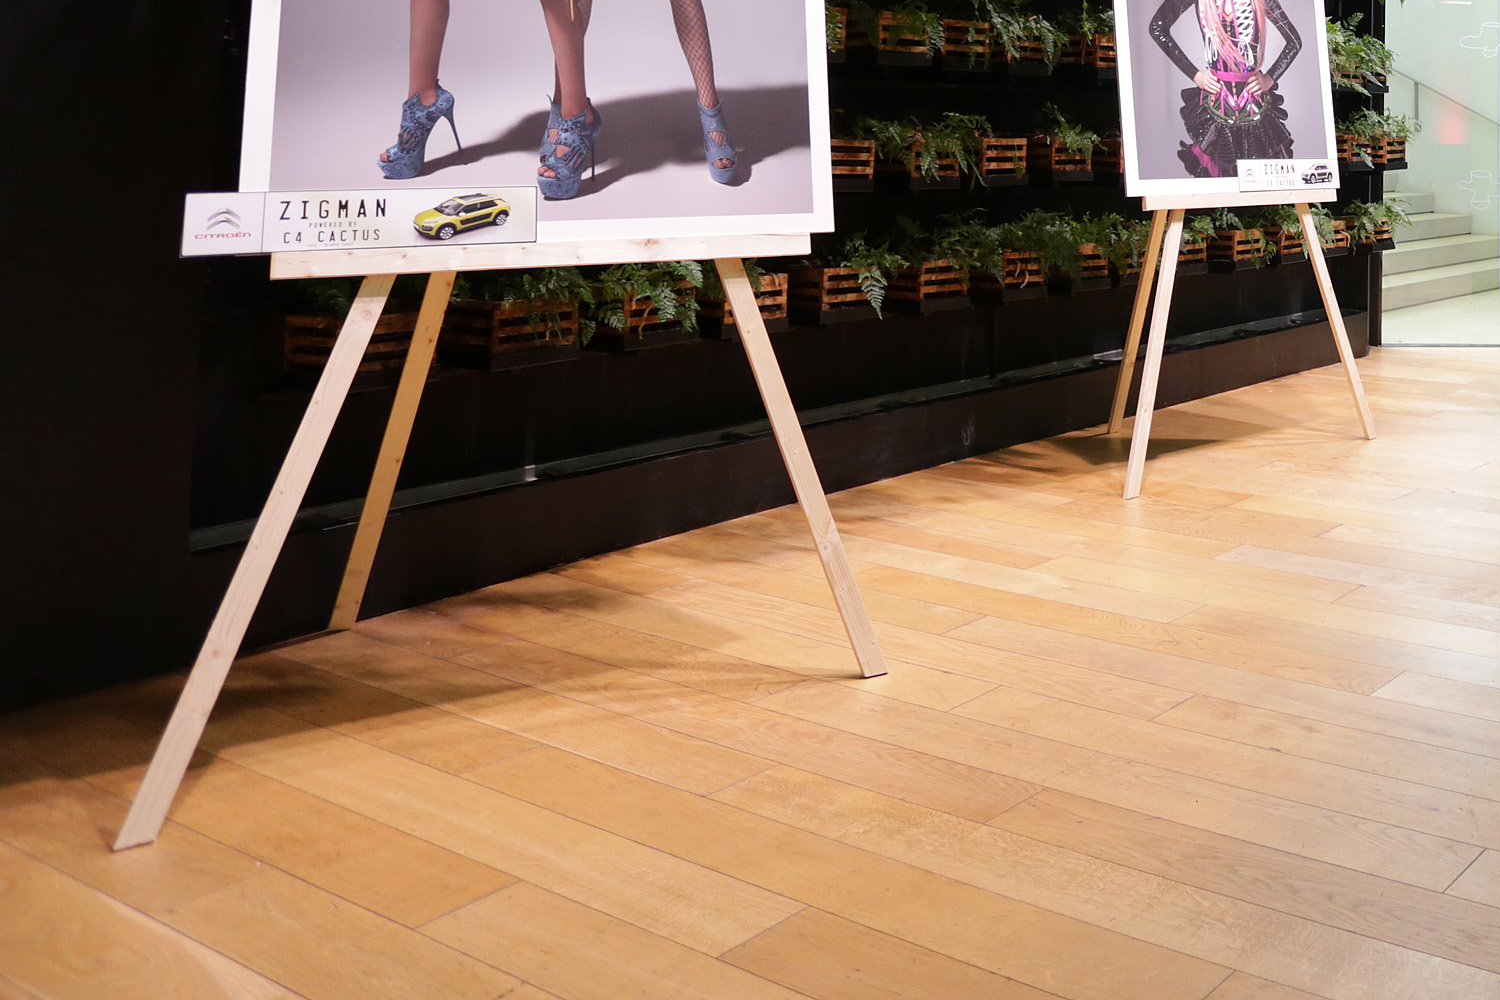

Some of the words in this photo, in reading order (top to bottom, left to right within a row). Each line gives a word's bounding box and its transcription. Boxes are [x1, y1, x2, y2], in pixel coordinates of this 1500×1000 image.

[1264, 164, 1296, 175] ZIGMAN
[279, 198, 387, 221] ZIGMAN
[283, 231, 302, 244] C4
[317, 228, 380, 243] CACTUS
